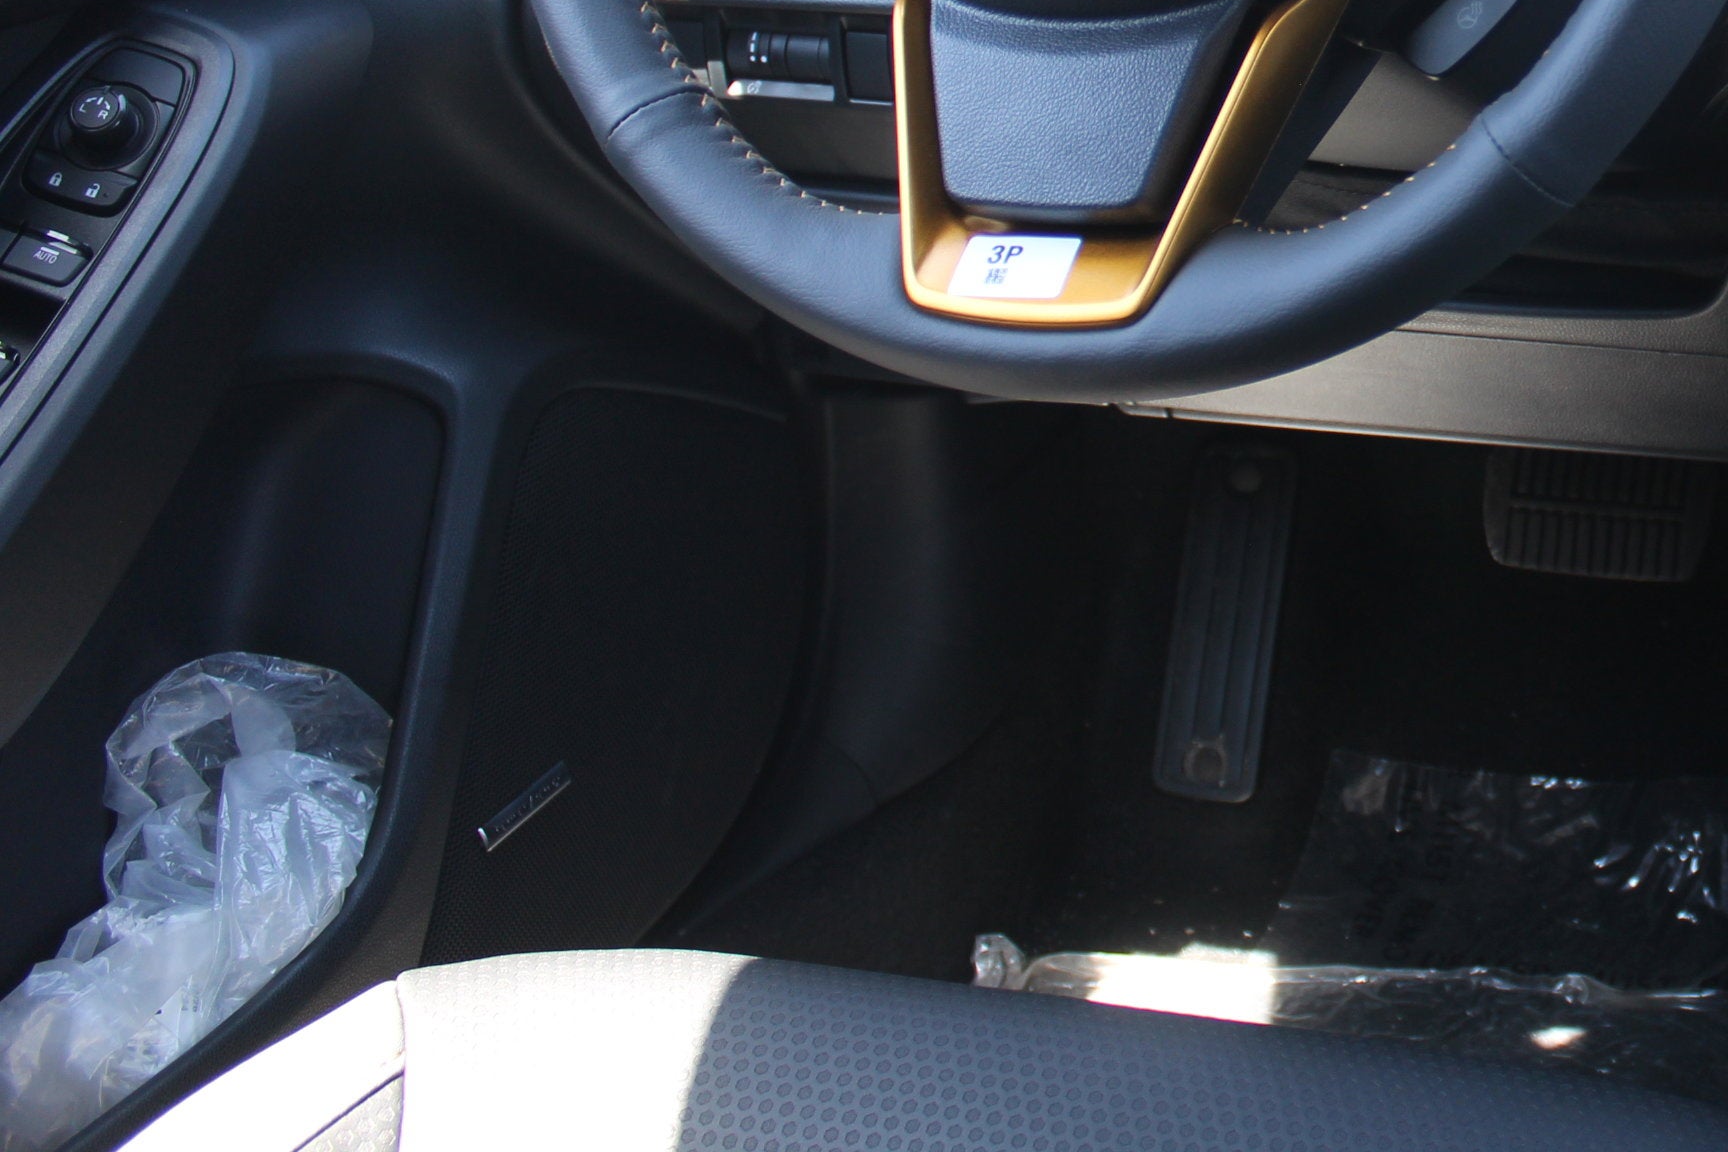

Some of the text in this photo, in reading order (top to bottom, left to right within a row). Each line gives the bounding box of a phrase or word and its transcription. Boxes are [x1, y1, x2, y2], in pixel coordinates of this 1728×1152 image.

[97, 109, 109, 120] R
[33, 250, 58, 265] AUTO
[986, 245, 1024, 265] 3P
